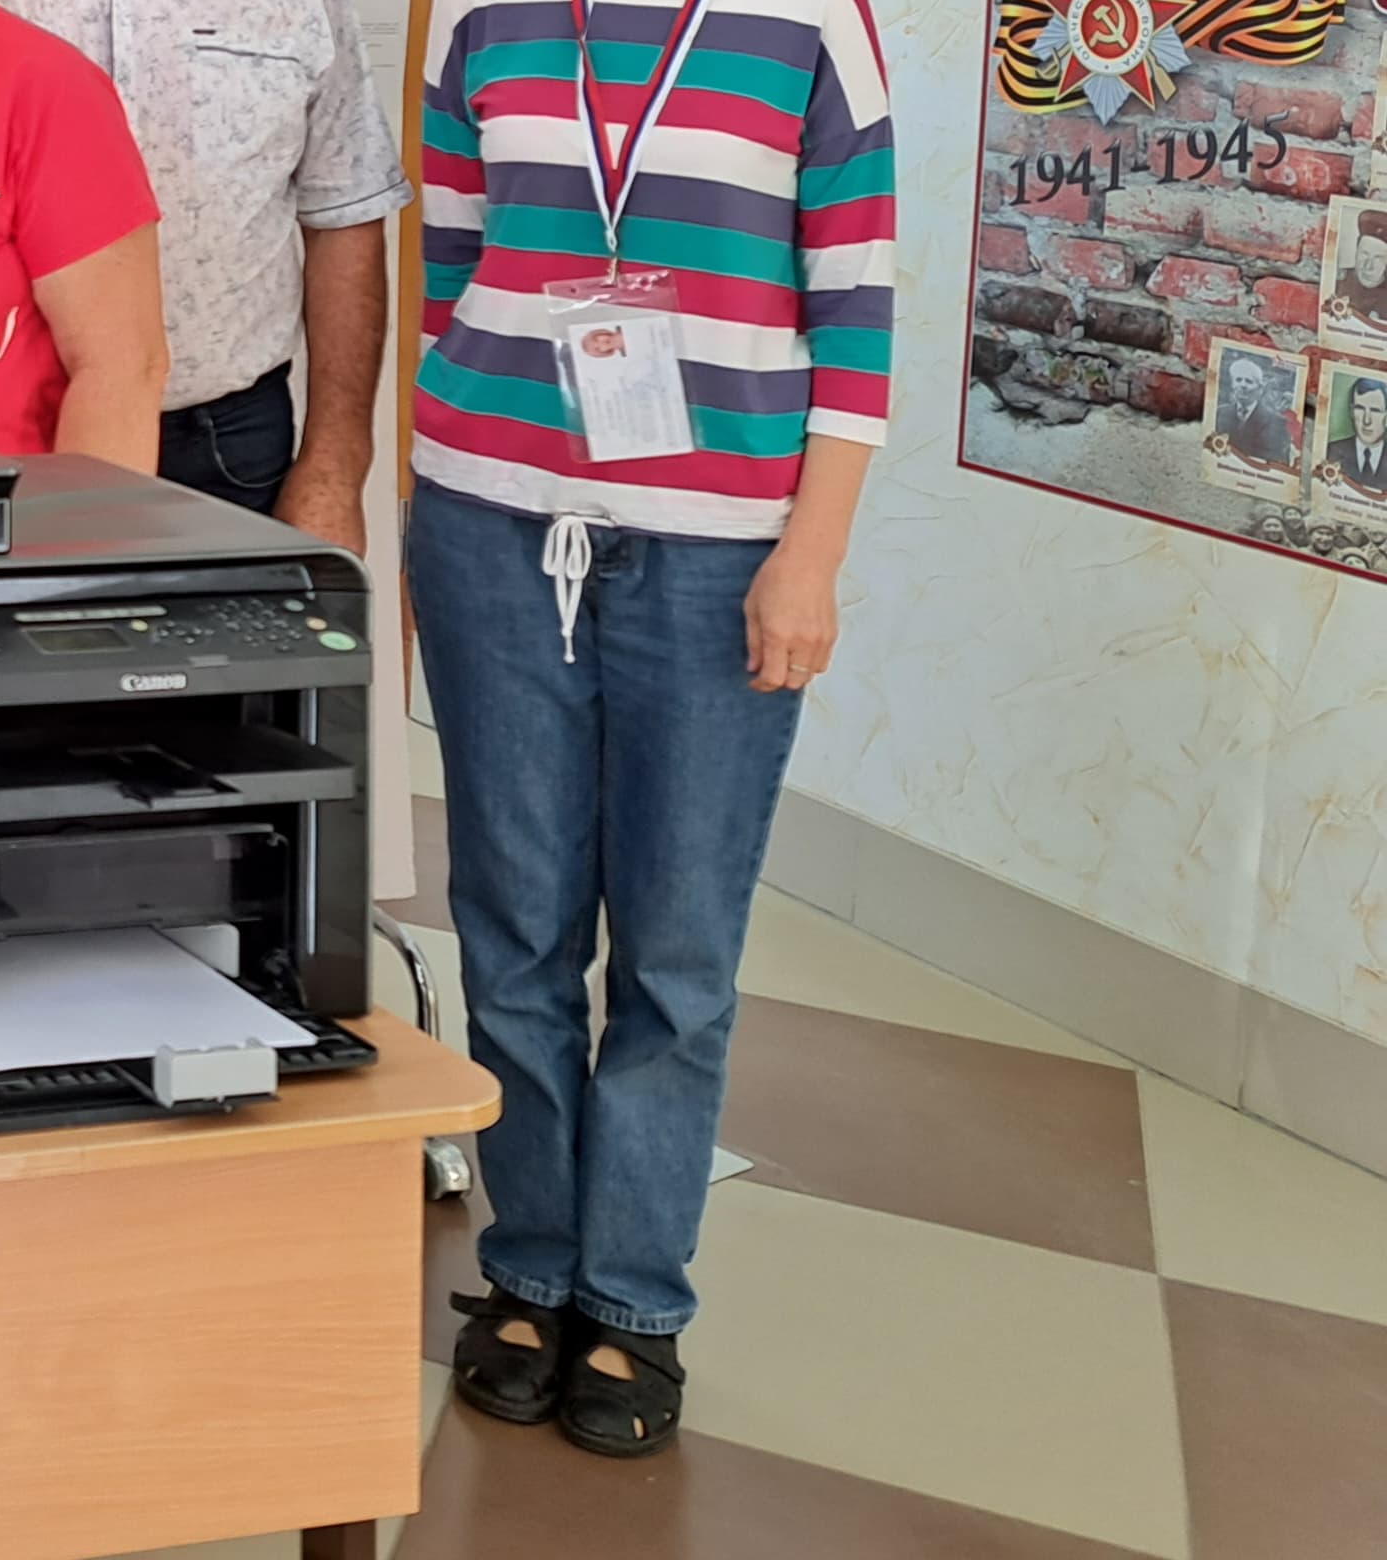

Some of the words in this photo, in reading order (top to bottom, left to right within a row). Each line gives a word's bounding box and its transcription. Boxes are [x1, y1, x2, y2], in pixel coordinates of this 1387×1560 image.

[1122, 15, 1150, 67] ВОЙНА
[1009, 109, 1291, 207] 1941-1945
[120, 672, 187, 693] Canon
